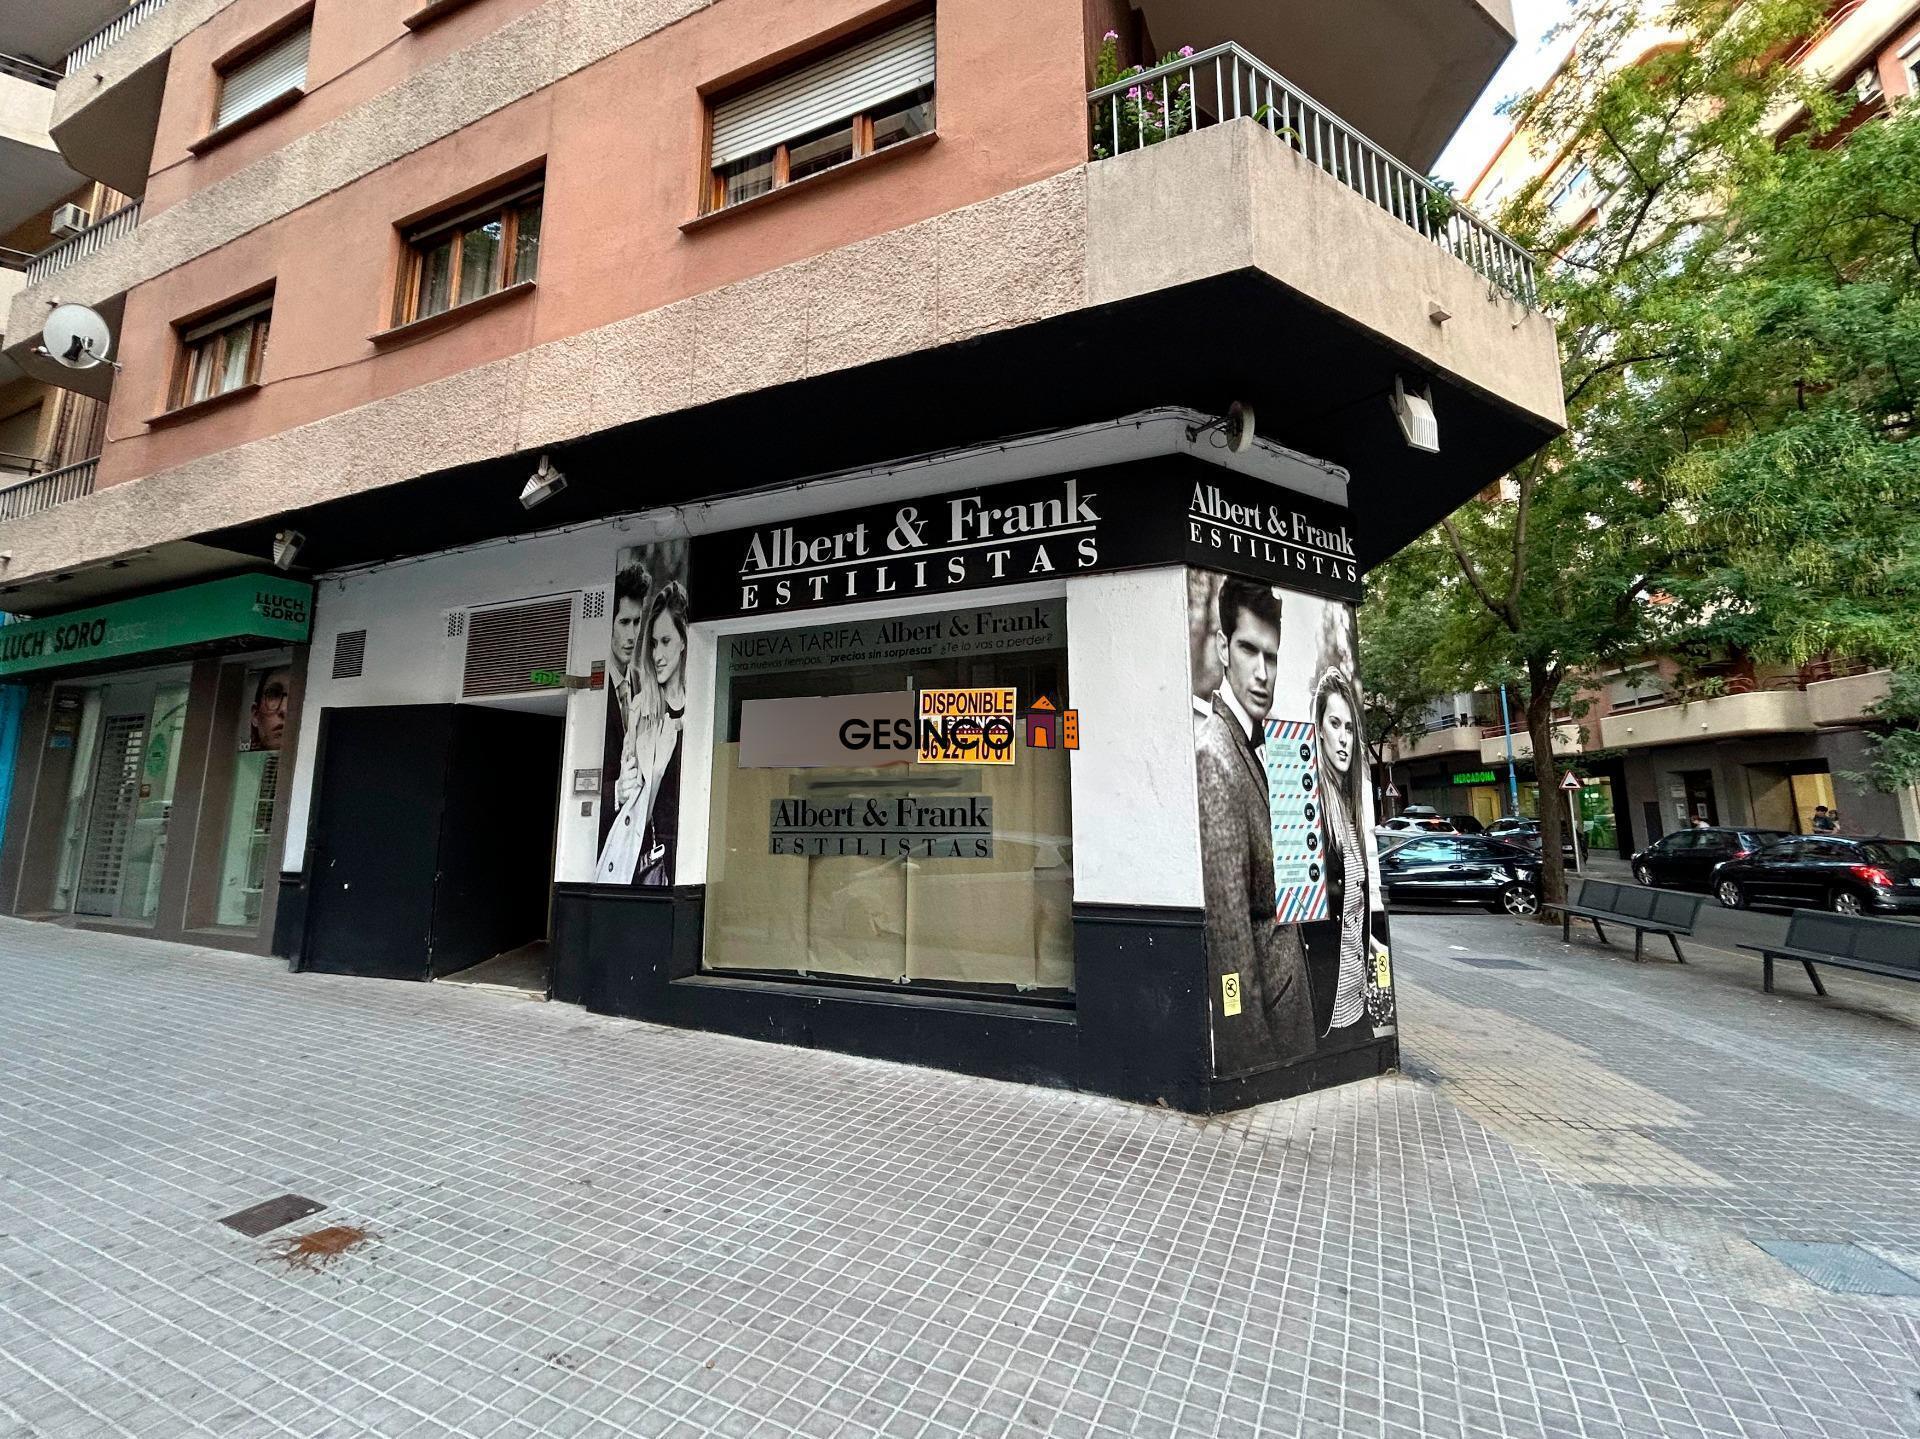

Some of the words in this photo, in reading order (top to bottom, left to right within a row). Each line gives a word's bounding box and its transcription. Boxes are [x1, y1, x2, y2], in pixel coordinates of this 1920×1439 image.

[738, 522, 870, 574] Albert
[886, 506, 929, 551] &
[946, 479, 1102, 544] Frank
[1188, 481, 1263, 530] Albert
[1267, 505, 1288, 537] &
[1290, 511, 1356, 556] Frank
[1189, 521, 1357, 583] ESTILISTAS
[740, 537, 1099, 610] ESTILISTAS
[256, 591, 304, 611] LLUCH
[0, 629, 45, 662] LUCH
[730, 636, 793, 659] NUEVA
[799, 628, 864, 653] TARIFA
[876, 617, 942, 645] Albert
[949, 615, 970, 638] &
[975, 606, 1050, 635] Frank
[869, 649, 882, 660] sin
[961, 640, 972, 651] lo
[975, 638, 993, 649] vas
[996, 638, 1004, 649] a
[922, 691, 1014, 714] DISPONIBLE
[773, 799, 855, 828] Albert
[862, 798, 888, 827] &
[895, 797, 990, 828] Frank
[772, 836, 989, 859] ESTILISTAS
